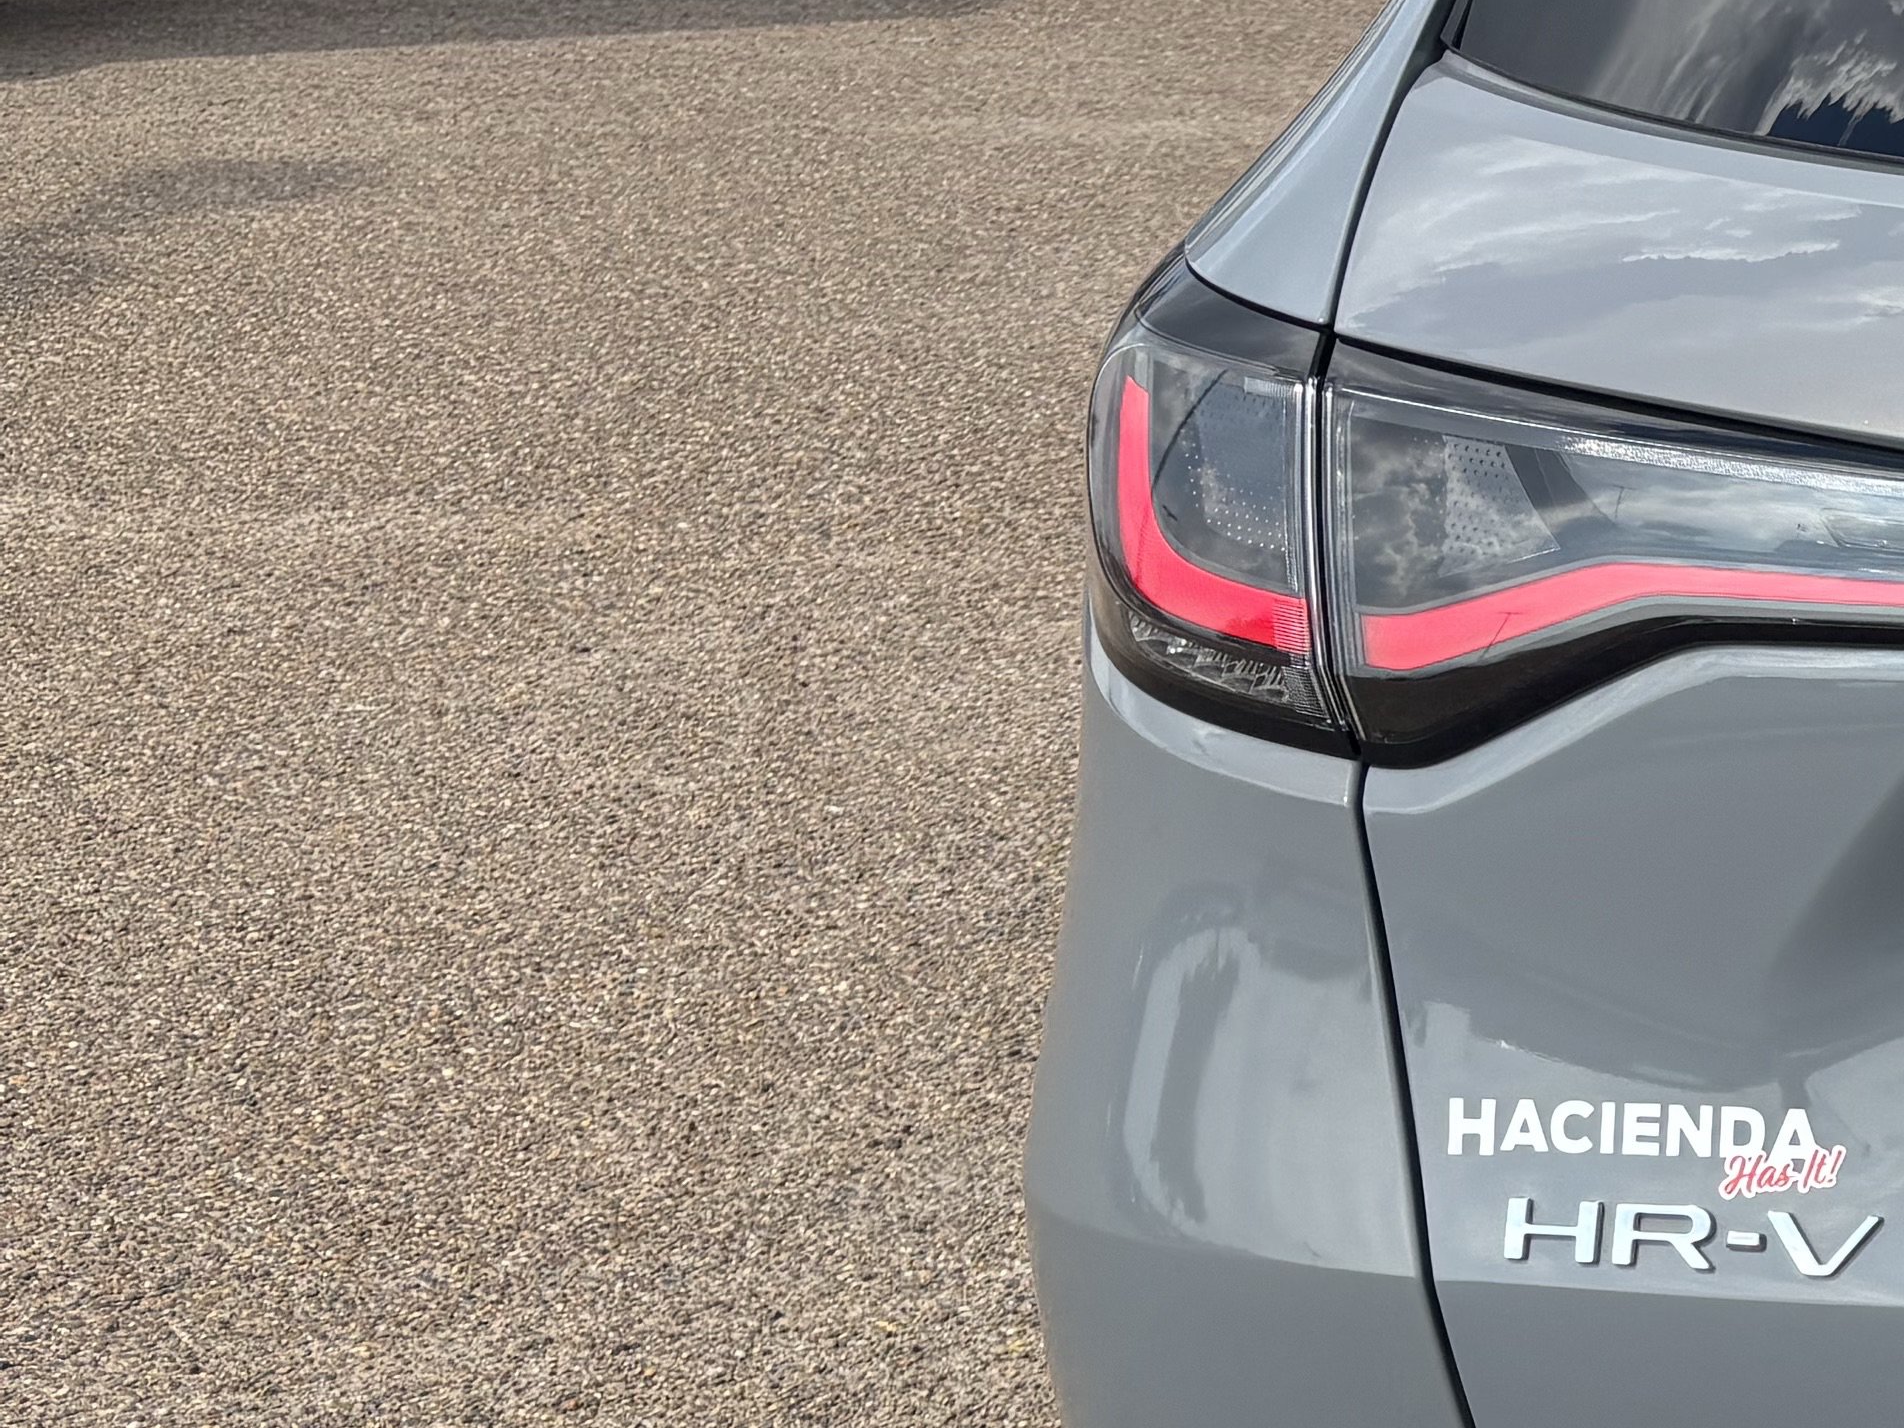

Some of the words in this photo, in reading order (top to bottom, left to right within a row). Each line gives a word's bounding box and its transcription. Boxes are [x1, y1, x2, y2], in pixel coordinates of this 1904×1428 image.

[1446, 1097, 1822, 1162] HACIENDA
[1722, 1153, 1792, 1195] Has
[1802, 1148, 1843, 1189] It!
[1502, 1195, 1884, 1277] HR-V
